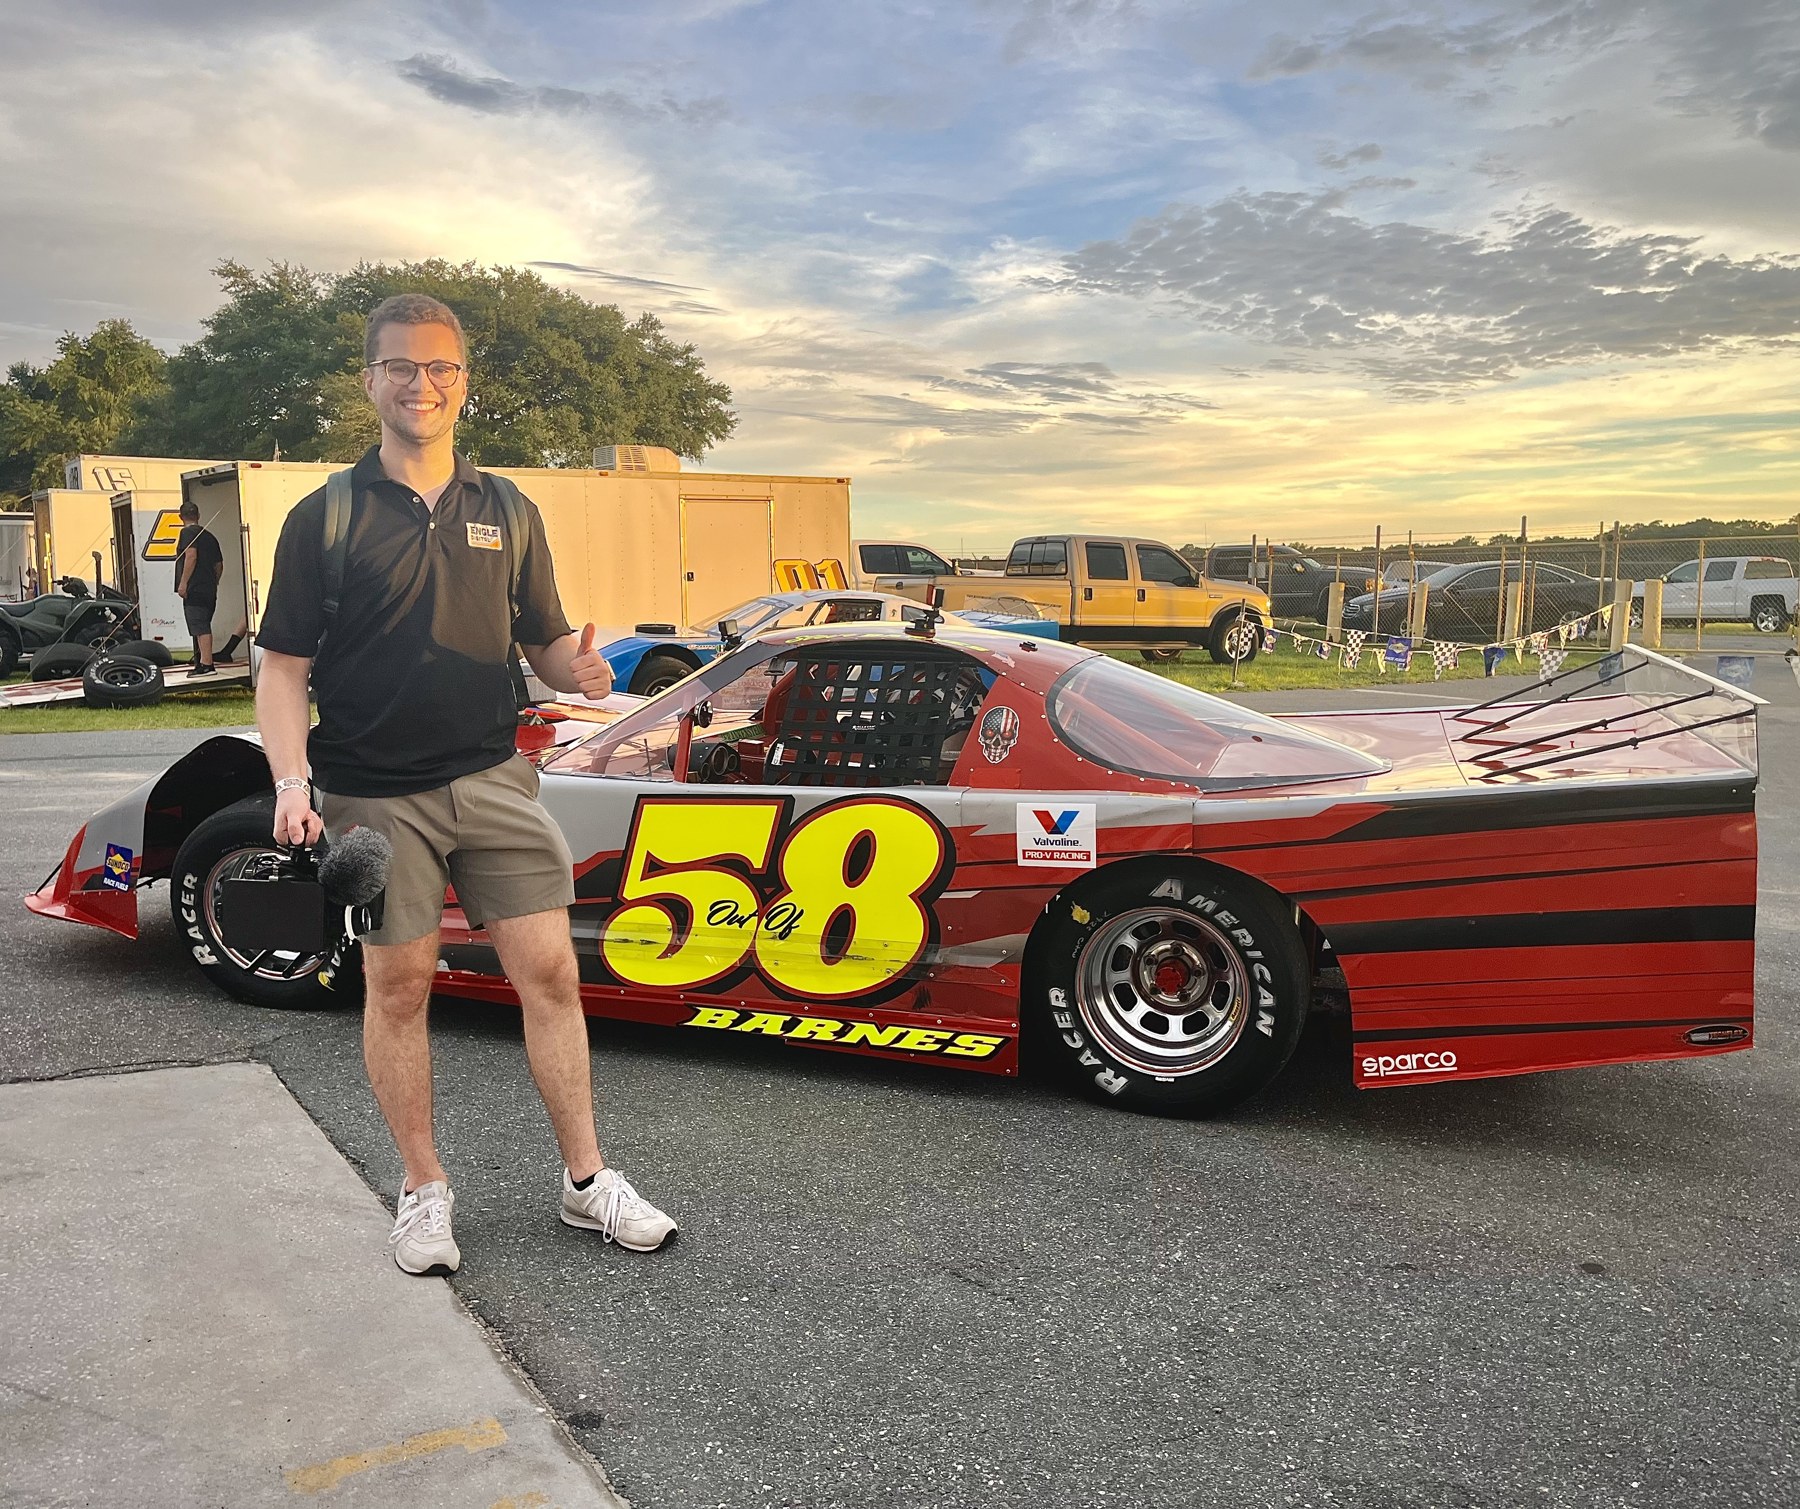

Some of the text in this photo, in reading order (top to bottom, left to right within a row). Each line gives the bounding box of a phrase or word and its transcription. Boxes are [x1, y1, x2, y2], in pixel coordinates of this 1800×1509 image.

[470, 526, 498, 538] ENGLE
[1025, 851, 1087, 860] PRO-V RACING
[1033, 837, 1080, 847] Valvoline
[107, 857, 129, 871] SUNOCO
[103, 877, 129, 892] RACE FUELS
[601, 797, 945, 999] 58
[181, 872, 219, 966] RACER
[706, 899, 805, 941] Out Of
[1149, 878, 1276, 1038] AMERICAN
[683, 1006, 1005, 1058] BARNES
[1048, 987, 1129, 1096] RACER
[1361, 1051, 1457, 1077] sparco
